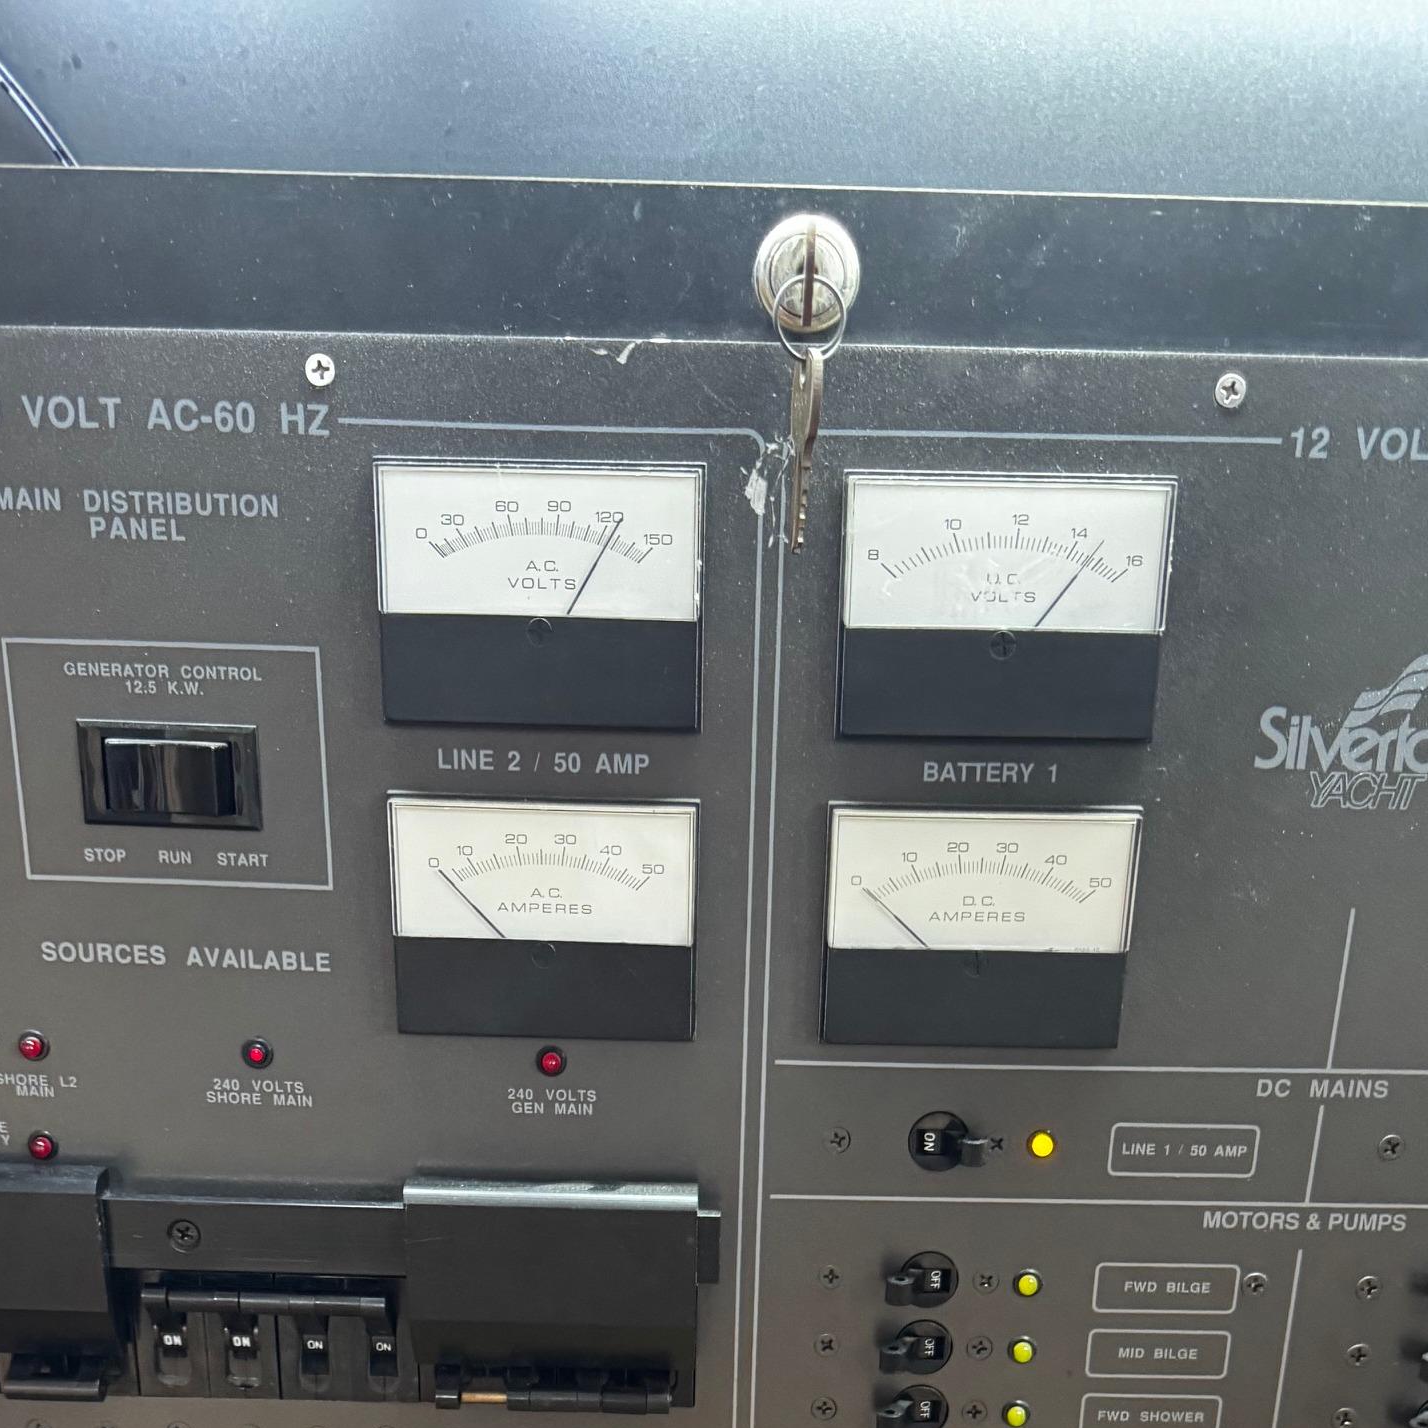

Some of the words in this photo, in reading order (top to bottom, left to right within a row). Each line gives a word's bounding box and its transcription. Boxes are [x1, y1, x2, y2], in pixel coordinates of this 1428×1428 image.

[21, 397, 121, 429] VOLT
[147, 398, 256, 433] AC-60
[280, 403, 330, 437] HZ
[1289, 427, 1330, 459] 12
[83, 490, 279, 517] DISTRIBUTION
[90, 518, 187, 542] PANEL
[441, 514, 465, 526] 30
[495, 501, 519, 512] 60
[547, 501, 571, 512] 90
[595, 511, 624, 524] 120
[644, 533, 673, 546] 150
[945, 519, 962, 530] 10
[1012, 514, 1029, 525] 12
[1071, 528, 1088, 540] 14
[1126, 555, 1143, 567] 16
[508, 577, 577, 590] VOLTS
[63, 663, 170, 678] GENERATOR
[180, 665, 262, 682] CONTROL
[125, 681, 158, 694] 12.5
[168, 684, 205, 696] K.W.
[437, 749, 495, 771] LINE
[507, 752, 521, 771] 2
[553, 753, 581, 773] 50
[595, 754, 650, 775] AMP
[923, 763, 1035, 784] BATTERY
[1048, 764, 1057, 783] 1
[1309, 772, 1428, 810] YACHT
[84, 848, 125, 863] STOP
[158, 850, 192, 864] RUN
[217, 853, 269, 868] START
[457, 845, 473, 856] 10
[505, 834, 527, 845] 20
[554, 834, 577, 845] 30
[600, 845, 622, 856] 40
[642, 864, 665, 875] 50
[902, 852, 917, 863] 10
[947, 842, 969, 853] 20
[996, 843, 1018, 853] 30
[1045, 855, 1067, 865] 40
[1090, 878, 1111, 888] 50
[497, 902, 592, 915] AMPERES
[929, 911, 1025, 922] AMPERES
[41, 942, 166, 966] SOURCES
[187, 948, 331, 973] AVAILABLE
[59, 1076, 77, 1088] L2
[213, 1079, 241, 1092] 240
[252, 1081, 304, 1094] VOLTS
[1256, 1080, 1291, 1098] DC
[1309, 1080, 1389, 1099] MAINS
[16, 1086, 55, 1098] MAIN
[206, 1092, 262, 1105] SHORE
[274, 1094, 313, 1108] MAIN
[507, 1089, 533, 1101] 240
[545, 1090, 597, 1102] VOLTS
[511, 1102, 545, 1115] GEN
[555, 1103, 593, 1116] MAIN
[924, 1133, 935, 1152] ON
[1122, 1144, 1155, 1156] LINE
[1164, 1145, 1170, 1156] 1
[1190, 1145, 1207, 1156] 50
[1214, 1145, 1247, 1158] AMP
[1203, 1212, 1296, 1231] MOTORS
[1307, 1214, 1321, 1230] &
[1328, 1214, 1406, 1231] PUMPS
[931, 1271, 941, 1289] OFF
[1124, 1282, 1156, 1292] FWD
[1166, 1282, 1211, 1294] BILGE
[163, 1335, 182, 1346] ON
[232, 1336, 251, 1347] ON
[307, 1340, 324, 1350] ON
[376, 1342, 392, 1352] ON
[925, 1339, 934, 1356] OFF
[1118, 1348, 1145, 1359] MID
[1153, 1348, 1198, 1360] BILGE
[1097, 1411, 1130, 1422] FWD
[1140, 1411, 1204, 1422] SHOWER
